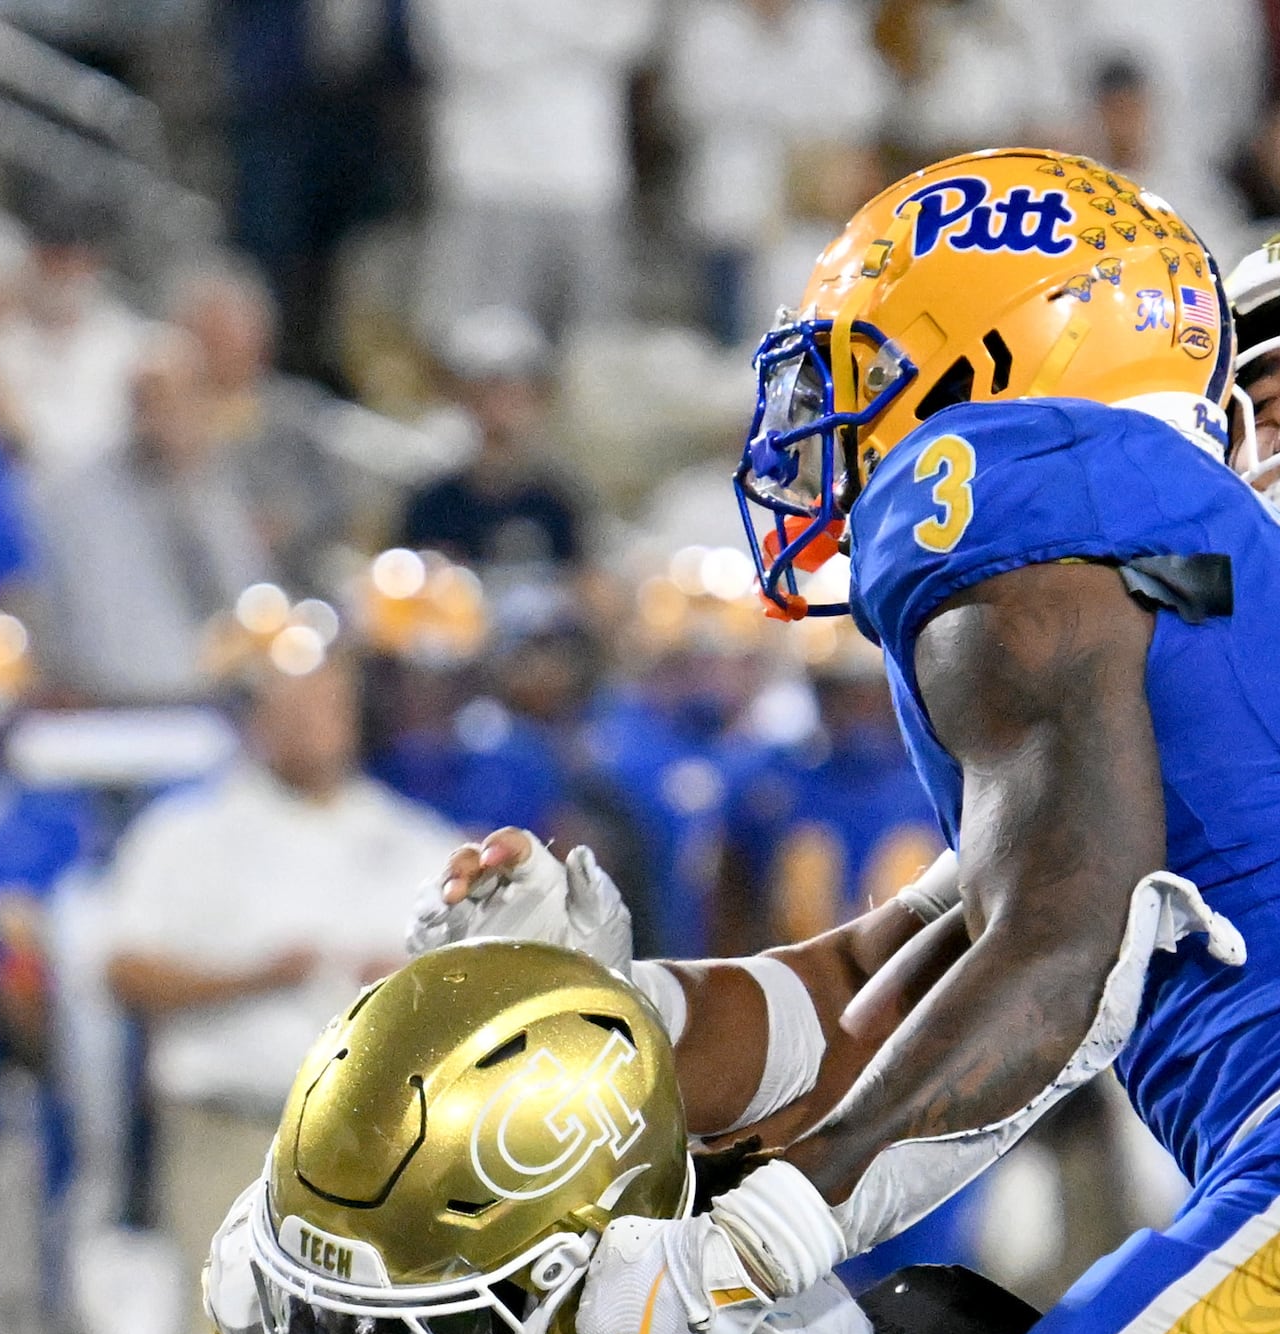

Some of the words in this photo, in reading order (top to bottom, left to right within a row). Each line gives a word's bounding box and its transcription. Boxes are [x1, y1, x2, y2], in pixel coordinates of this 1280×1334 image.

[894, 175, 1075, 258] Pitt
[1185, 334, 1210, 349] ACC
[913, 433, 977, 554] 3
[300, 1227, 353, 1279] TECH
